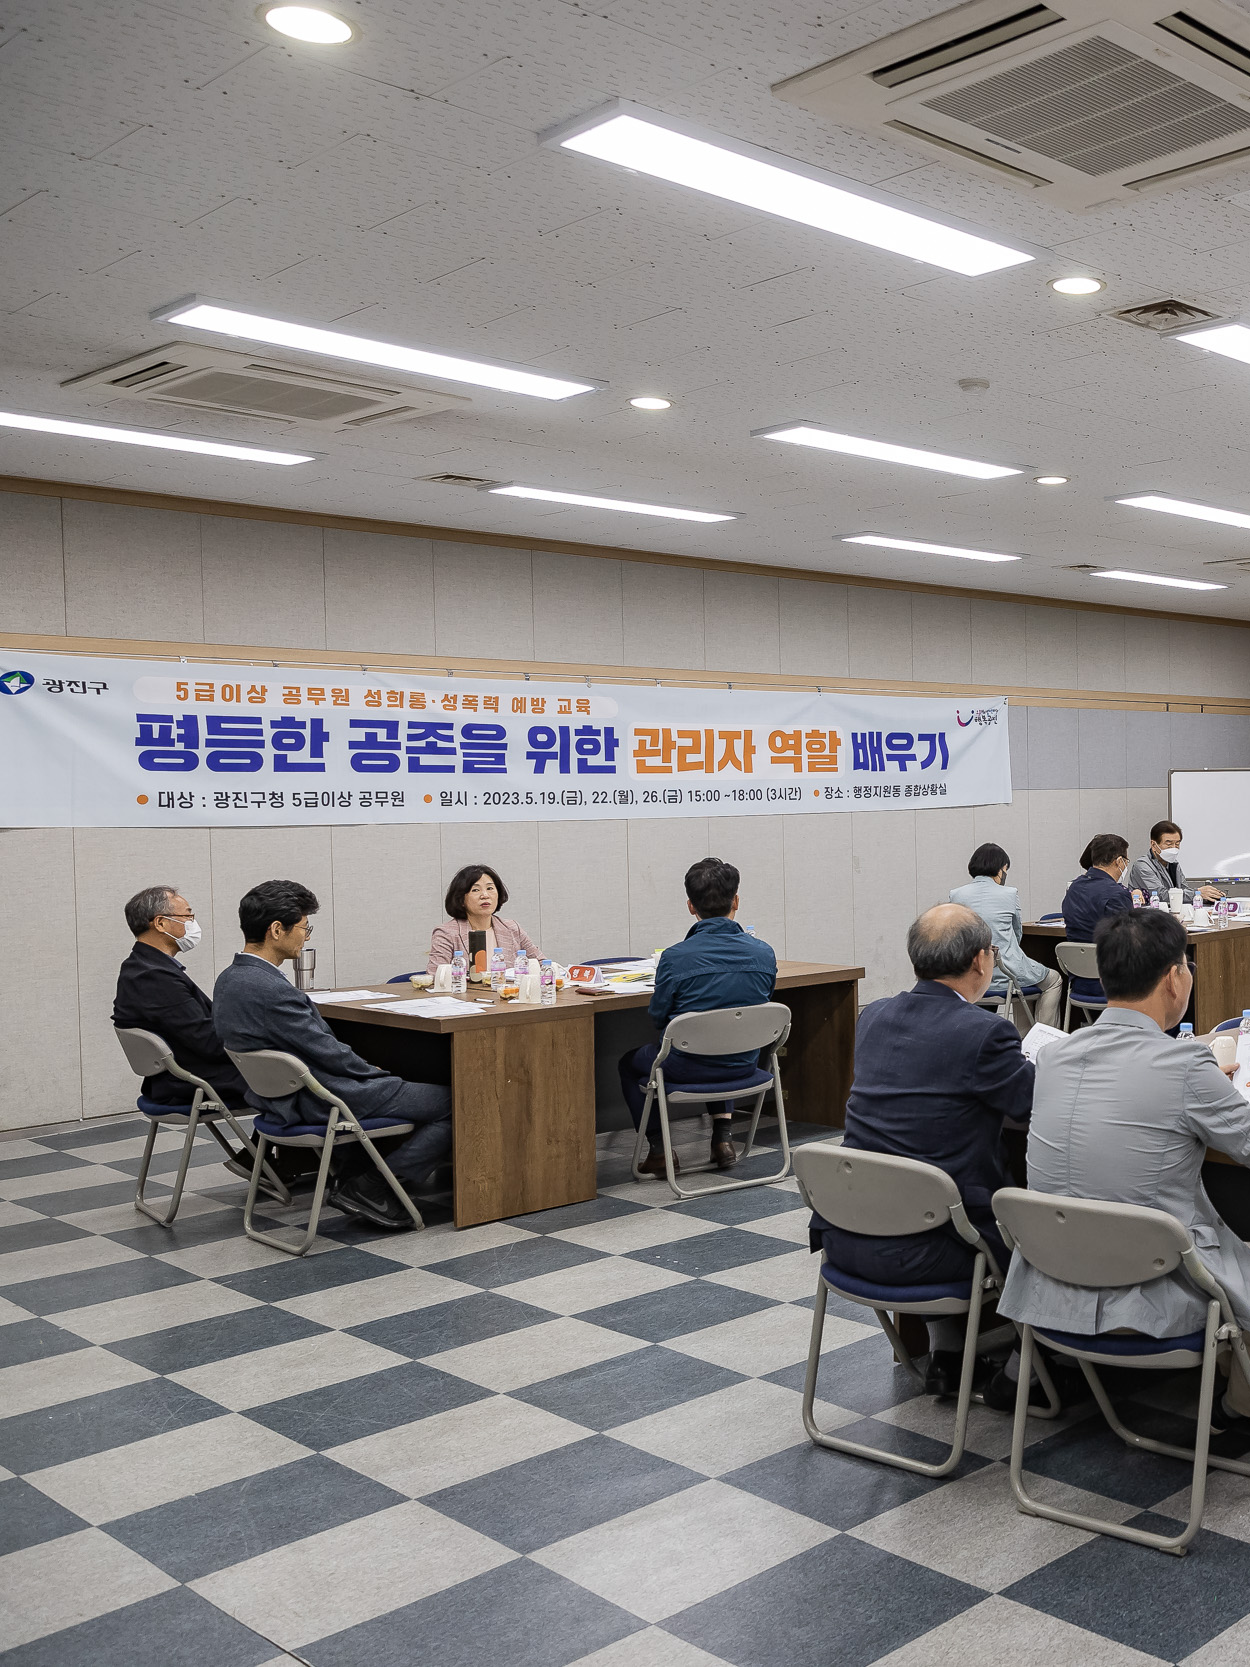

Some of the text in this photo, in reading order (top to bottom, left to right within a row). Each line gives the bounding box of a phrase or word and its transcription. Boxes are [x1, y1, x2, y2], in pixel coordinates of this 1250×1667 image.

[42, 679, 108, 695] 광진구
[176, 682, 590, 715] 5급이상 공무원 성희롱·성폭력 예방 교육
[135, 714, 949, 774] 평등한 공존을 위한 관리자 역할 배우기
[159, 792, 194, 808] 대상
[214, 791, 284, 808] 광진구청
[293, 791, 353, 807] 5급이상
[359, 791, 404, 807] 공무원
[440, 791, 467, 806] 일시
[483, 790, 586, 806] 2023.5.19.(금),
[592, 790, 637, 805] 22.(월),
[643, 789, 682, 804] 26.(금)
[688, 790, 720, 802] 15:00
[725, 789, 762, 801] ~18:00
[767, 787, 801, 801] (3시간)
[825, 787, 843, 799] 장소
[853, 786, 901, 798] 행정지원동
[905, 783, 946, 797] 종합상황실
